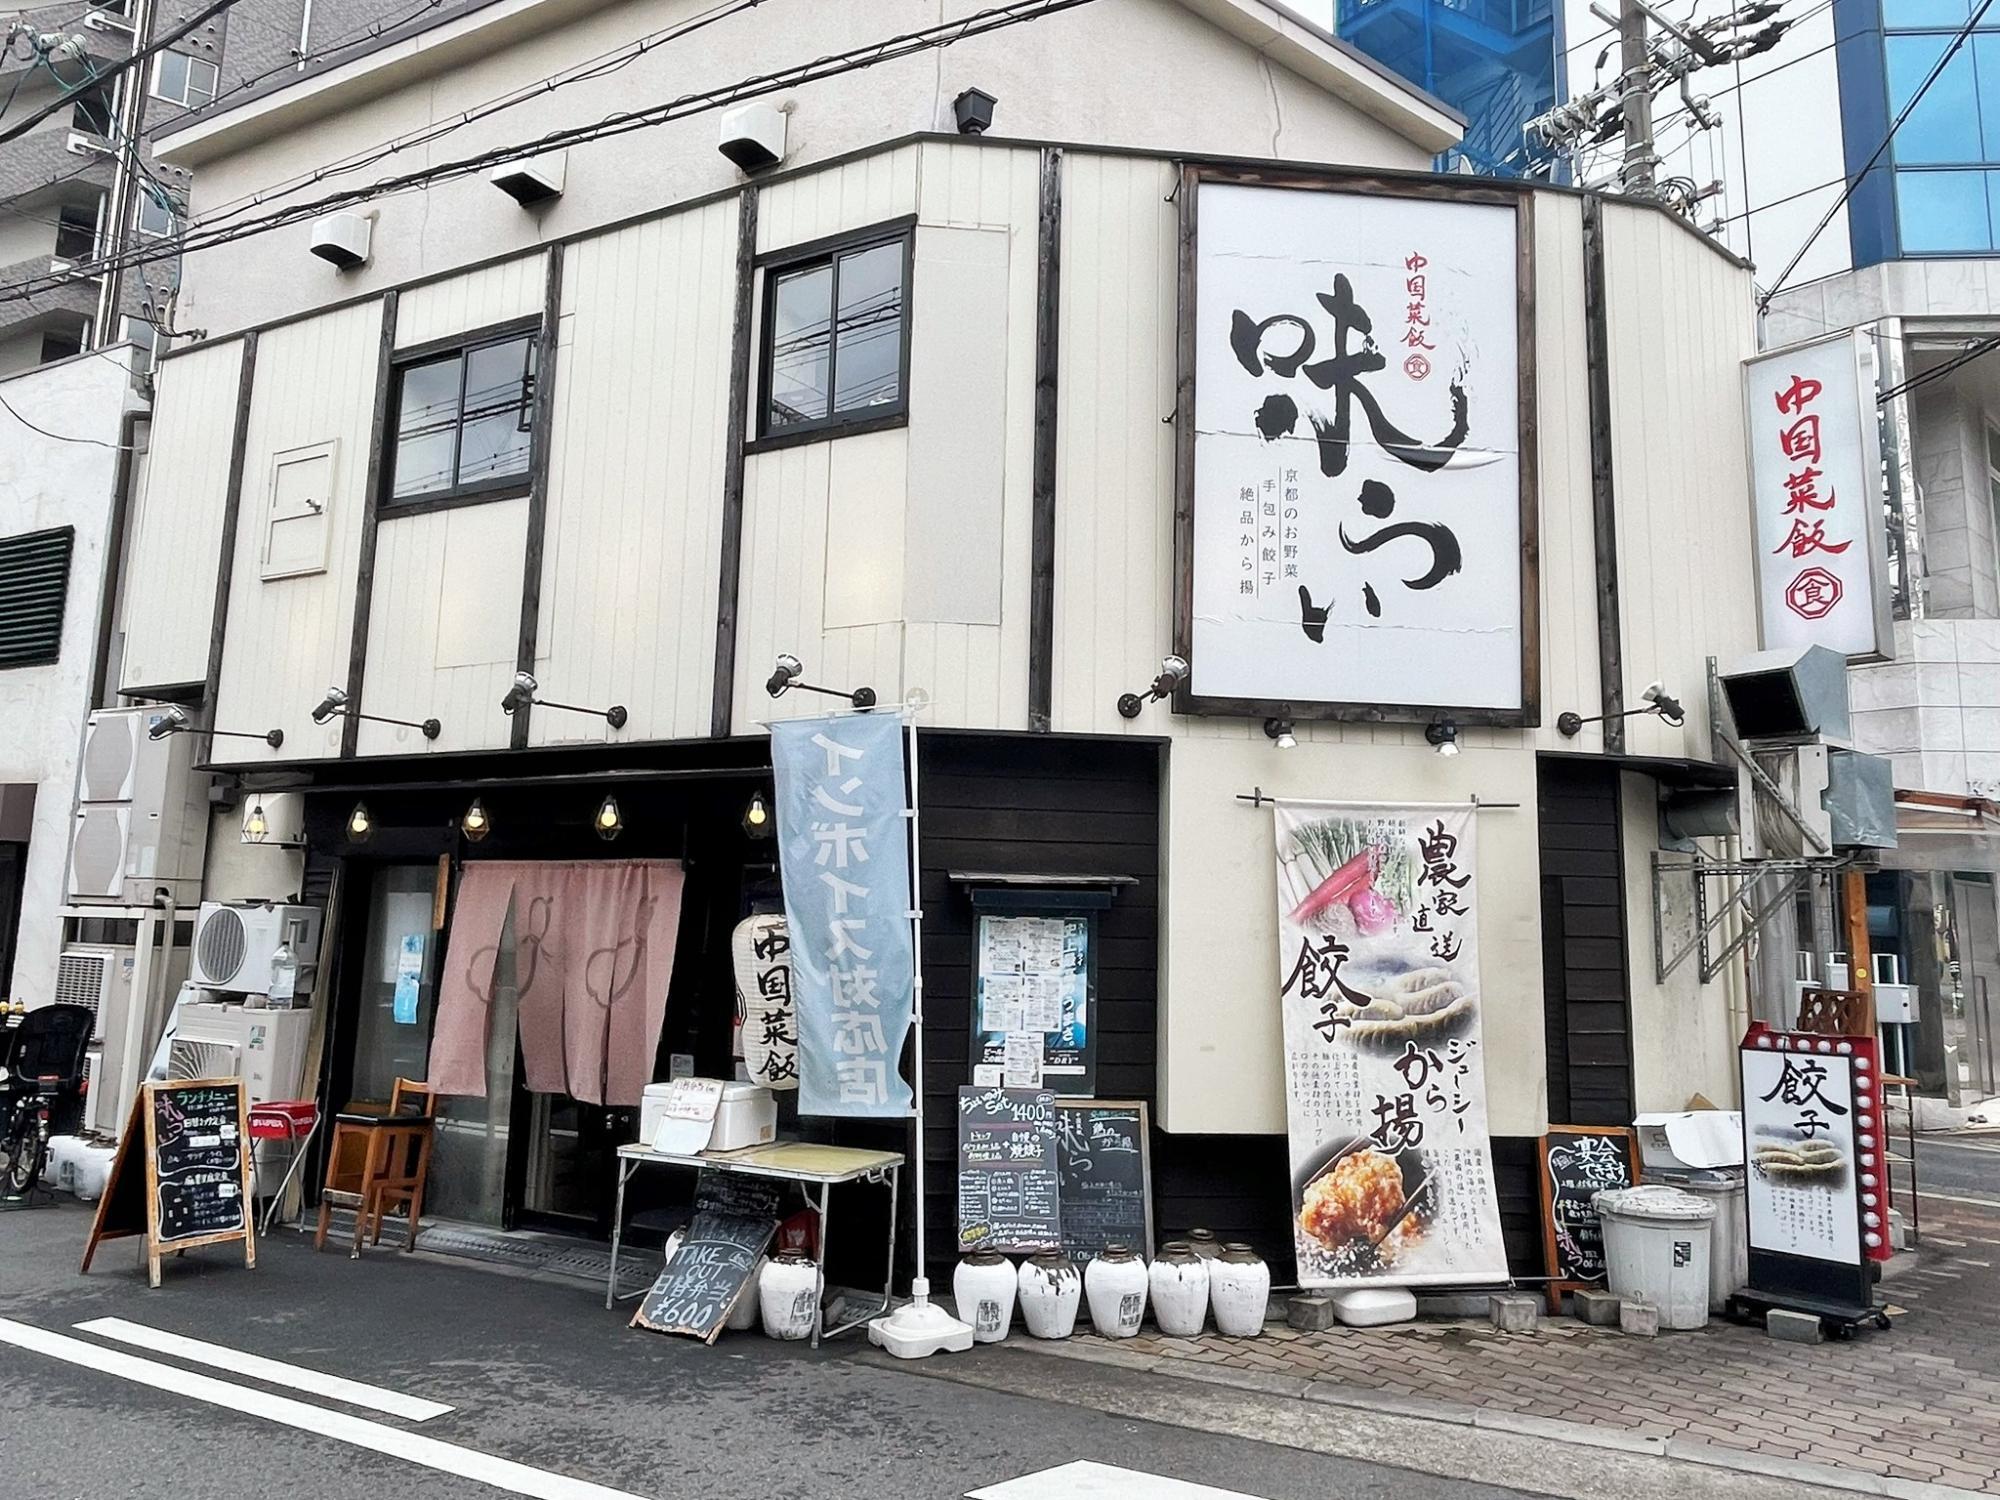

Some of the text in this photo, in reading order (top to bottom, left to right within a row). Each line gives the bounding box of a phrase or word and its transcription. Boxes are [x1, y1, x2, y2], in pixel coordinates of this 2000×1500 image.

[1400, 250, 1435, 351] 中国菜飯
[1230, 273, 1476, 643] 味らい
[1771, 374, 1854, 559] 中国菜飯
[1239, 485, 1254, 596] 絶品から揚
[1261, 479, 1276, 587] 手包み餃子
[1283, 468, 1299, 579] 京都のお野菜
[753, 929, 800, 1082] 中国菜飯
[1281, 935, 1372, 1043] 餃子
[1446, 1038, 1477, 1135] ジューシー
[1760, 1058, 1849, 1138] 餃子
[1573, 1136, 1622, 1164] 宴会
[651, 1275, 733, 1302] 日替弁当
[677, 1245, 723, 1266] TAKE
[685, 1261, 731, 1281] OUT
[650, 1296, 713, 1329] ¥600
